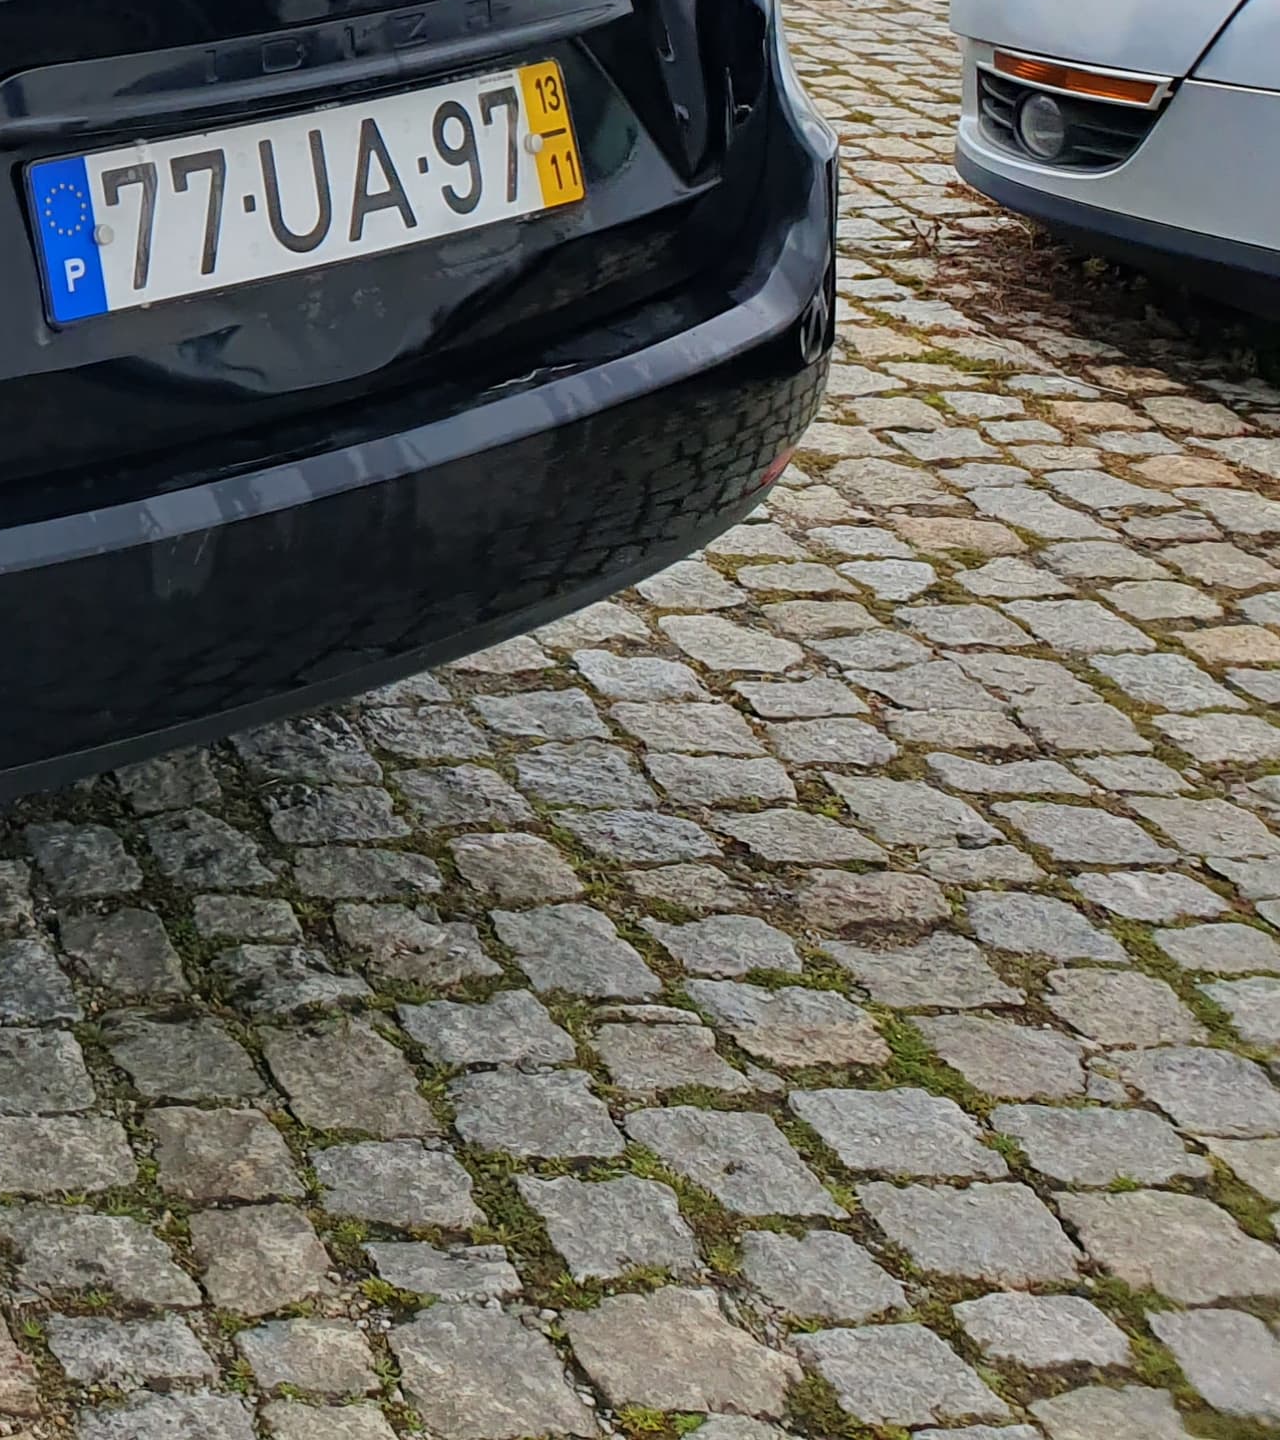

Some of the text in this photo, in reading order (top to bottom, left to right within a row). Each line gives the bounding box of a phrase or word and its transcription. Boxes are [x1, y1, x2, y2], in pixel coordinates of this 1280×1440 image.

[535, 75, 561, 114] 13
[550, 150, 578, 191] 11
[64, 257, 86, 293] P
